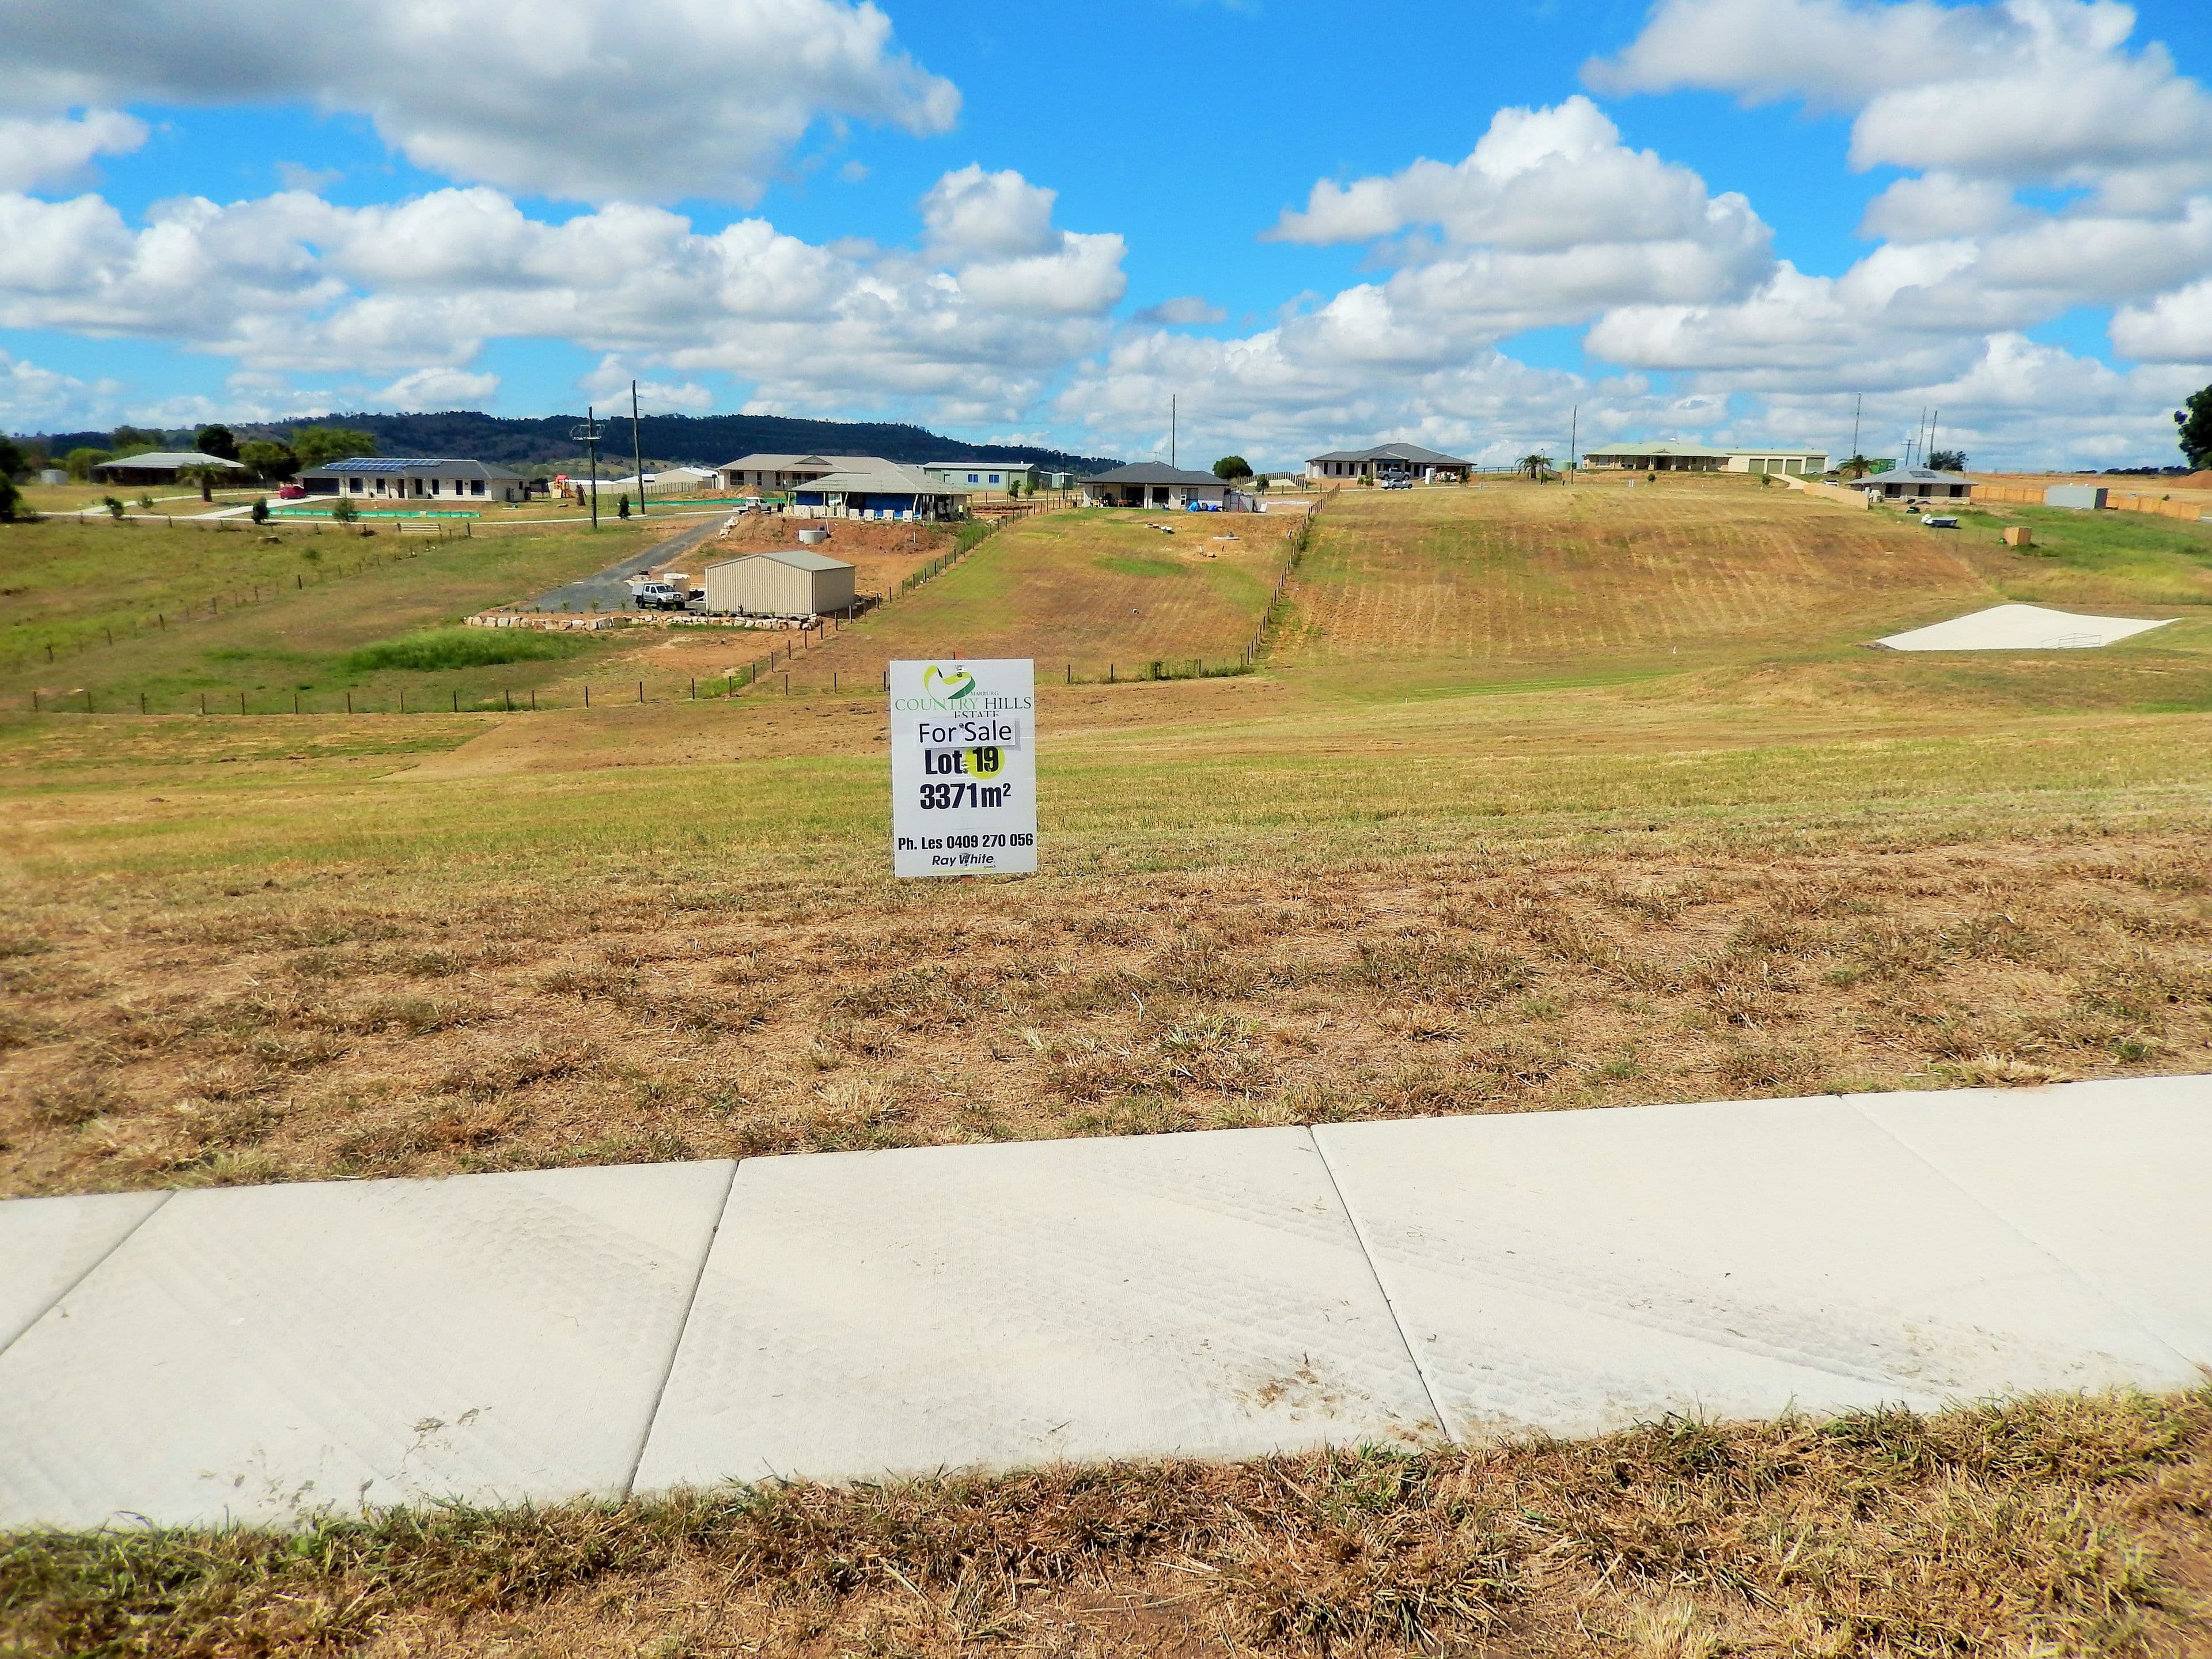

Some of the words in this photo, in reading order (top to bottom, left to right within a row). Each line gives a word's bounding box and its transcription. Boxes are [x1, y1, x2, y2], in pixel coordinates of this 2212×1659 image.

[895, 698, 978, 711] COUNTRY
[985, 696, 1032, 710] HILLS
[954, 710, 999, 719] ESTATE
[919, 723, 957, 743] For
[964, 719, 1012, 742] Sale
[925, 749, 963, 775] Lot
[972, 746, 999, 772] 19
[920, 782, 1012, 810] 3371m²
[898, 838, 918, 850] Ph.
[922, 837, 943, 850] Les
[946, 835, 978, 849] 0409
[982, 834, 1006, 848] 270
[1010, 833, 1033, 847] 056
[932, 855, 957, 867] Ray
